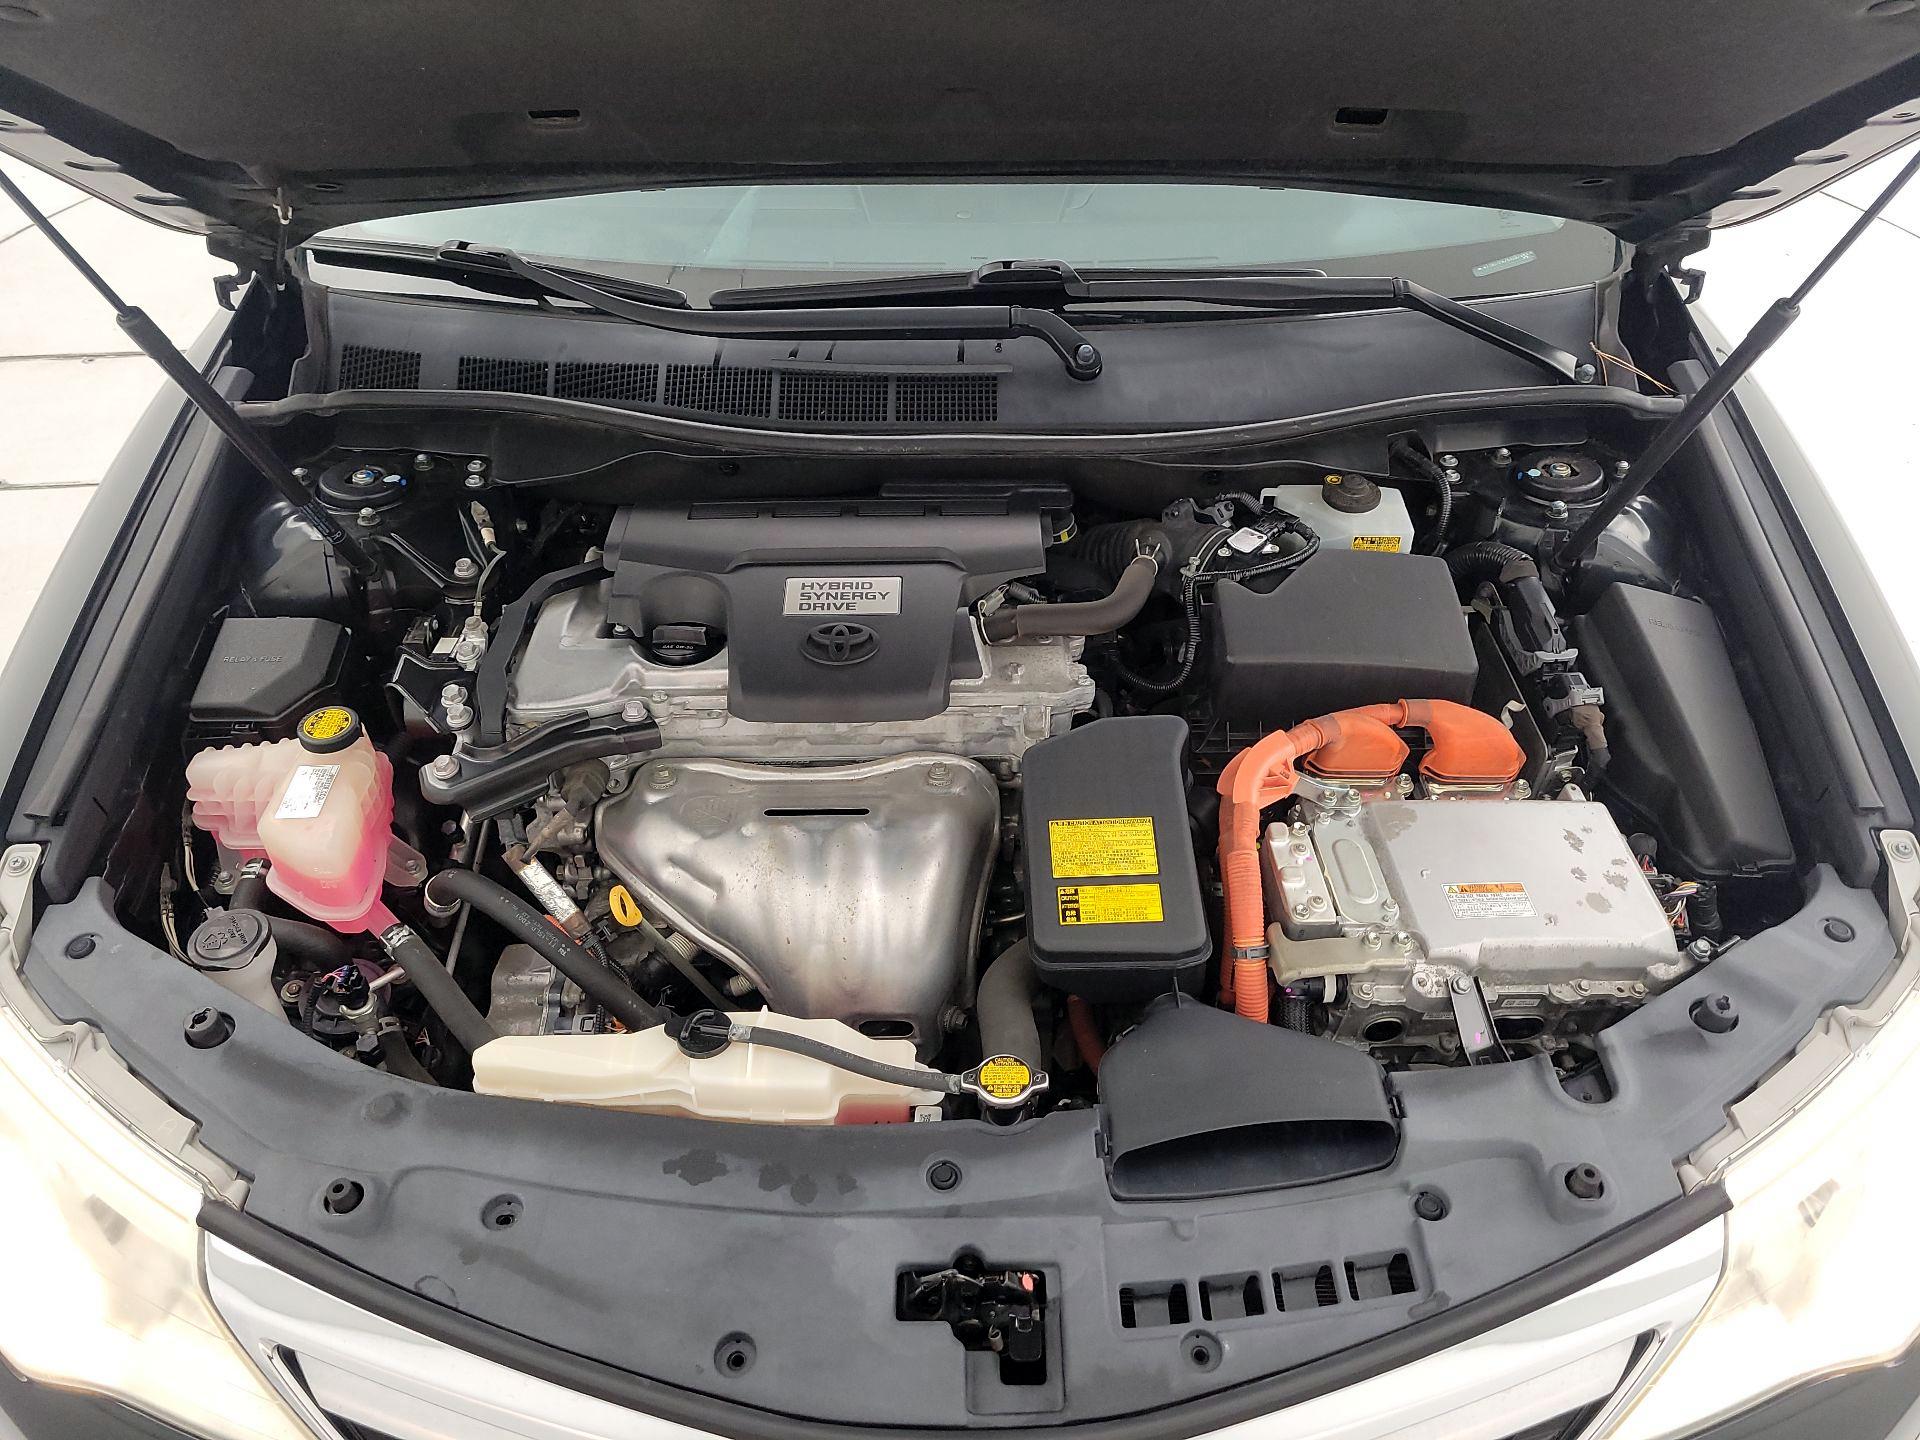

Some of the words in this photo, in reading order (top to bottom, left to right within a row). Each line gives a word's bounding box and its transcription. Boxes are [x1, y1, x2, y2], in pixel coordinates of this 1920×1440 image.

[800, 581, 873, 591] HYBRID
[799, 591, 891, 601] SYNERGY
[798, 601, 857, 611] DRIVE
[223, 656, 251, 664] RELAY
[260, 655, 282, 663] FUSE
